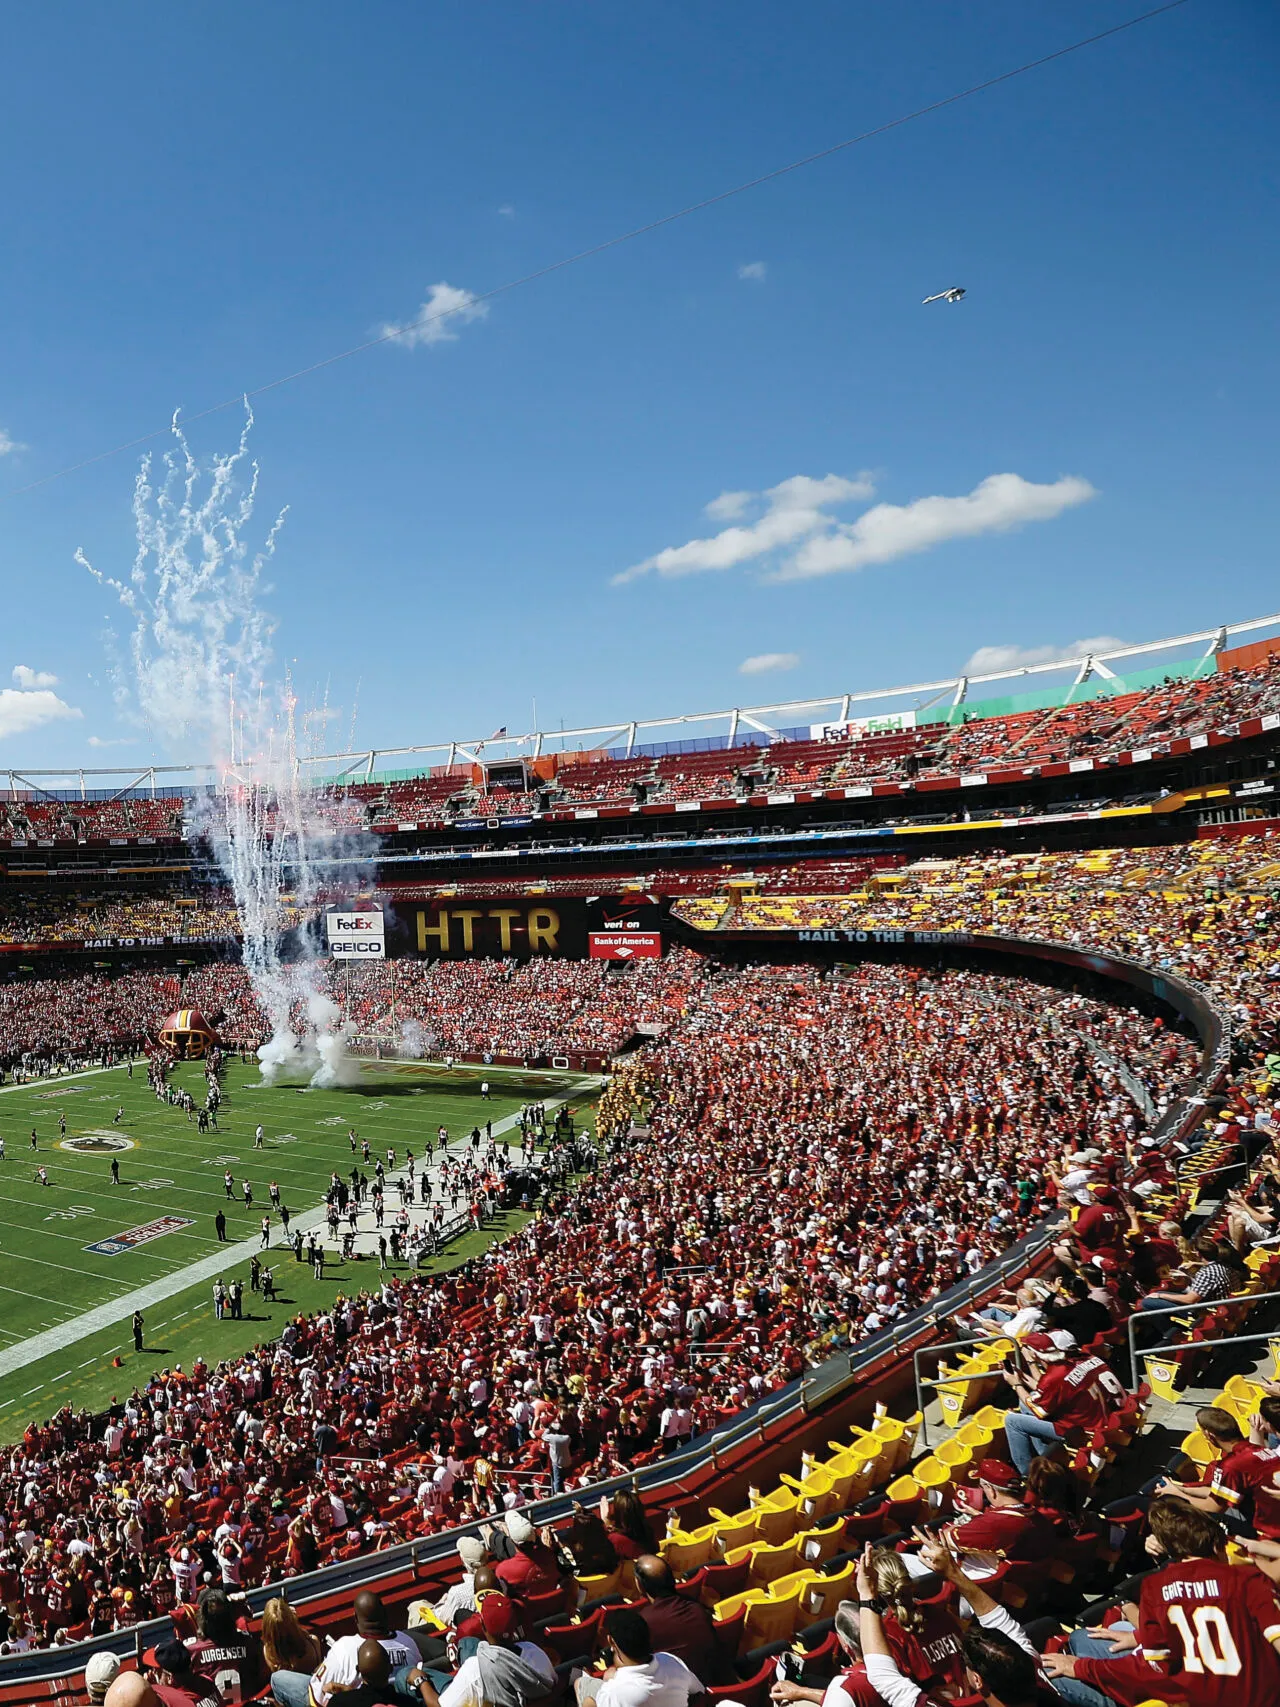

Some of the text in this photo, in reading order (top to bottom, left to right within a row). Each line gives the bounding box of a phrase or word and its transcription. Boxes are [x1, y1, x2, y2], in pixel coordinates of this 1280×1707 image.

[336, 918, 373, 930] FedEx
[416, 907, 561, 952] HTTR
[604, 920, 640, 931] verizon
[84, 939, 114, 948] HAIL
[117, 938, 135, 947] TO
[138, 936, 164, 946] THE
[594, 937, 655, 946] Bank of America
[798, 931, 975, 945] HAIL TO THE REDSKINS
[330, 942, 382, 953] GEICO
[49, 1204, 96, 1220] 30
[248, 1534, 264, 1549] 77
[1161, 1579, 1220, 1602] GRIFFIN III
[1167, 1604, 1243, 1677] 10
[200, 1646, 247, 1664] JURGENSEN
